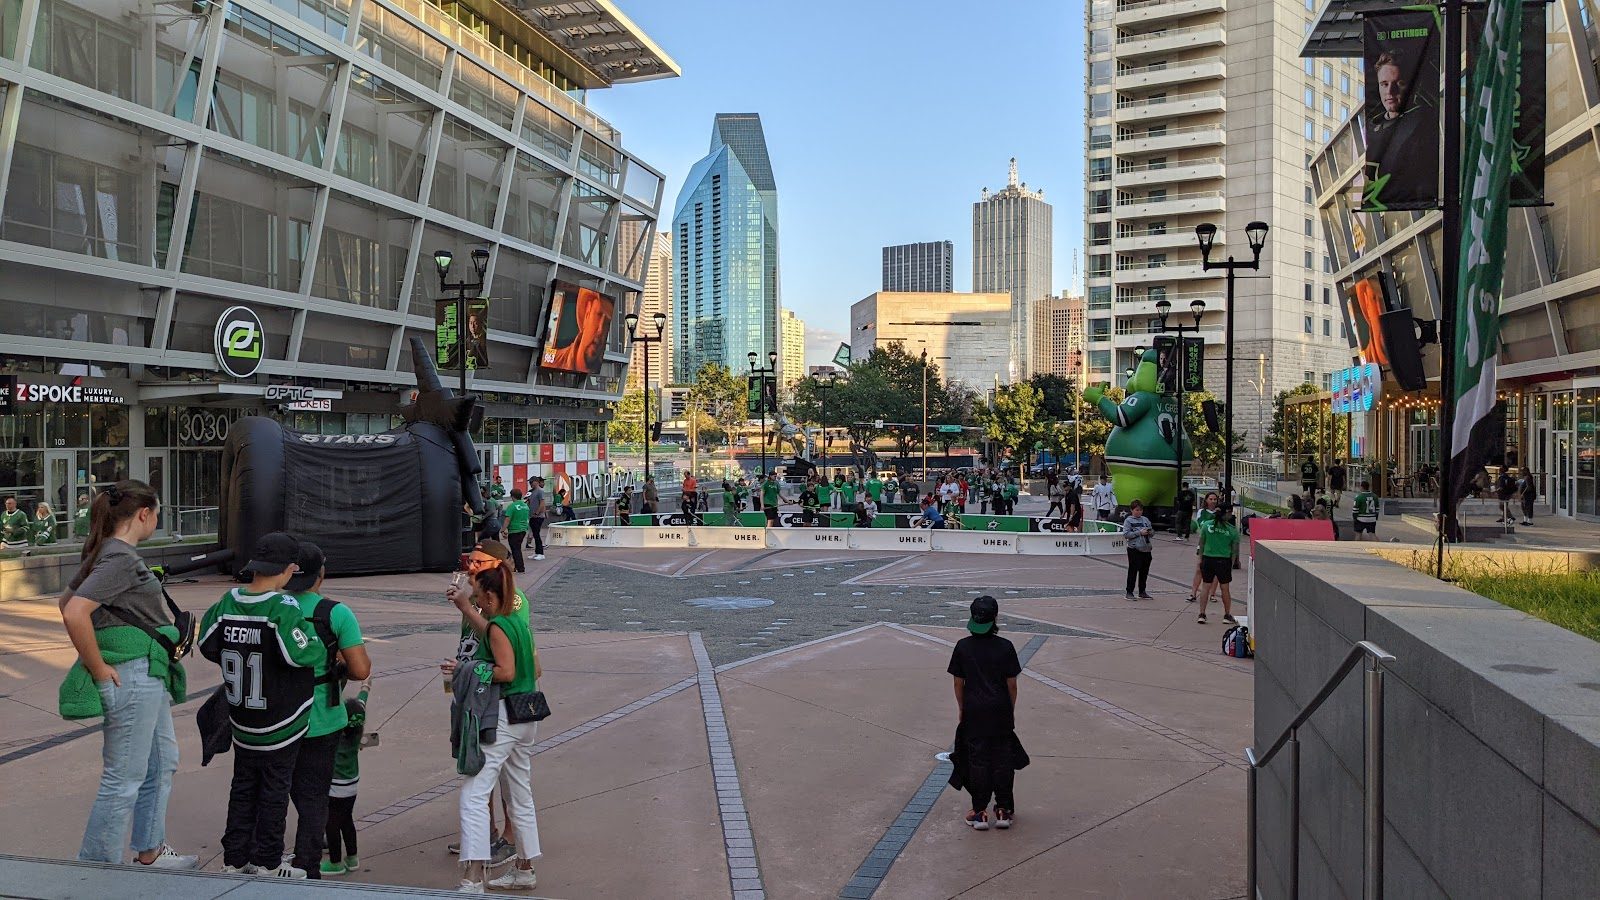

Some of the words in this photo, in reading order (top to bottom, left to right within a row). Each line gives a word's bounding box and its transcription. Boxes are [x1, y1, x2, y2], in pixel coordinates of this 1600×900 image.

[1391, 28, 1428, 39] OETTINGER
[447, 328, 457, 344] ONE
[266, 386, 314, 399] OPTIC
[293, 400, 330, 409] TICKETS
[179, 413, 229, 441] 3030
[299, 434, 395, 444] STARS
[572, 473, 600, 501] PNC
[1366, 500, 1376, 513] 14
[223, 626, 262, 645] SEGUIN
[221, 648, 267, 710] 91
